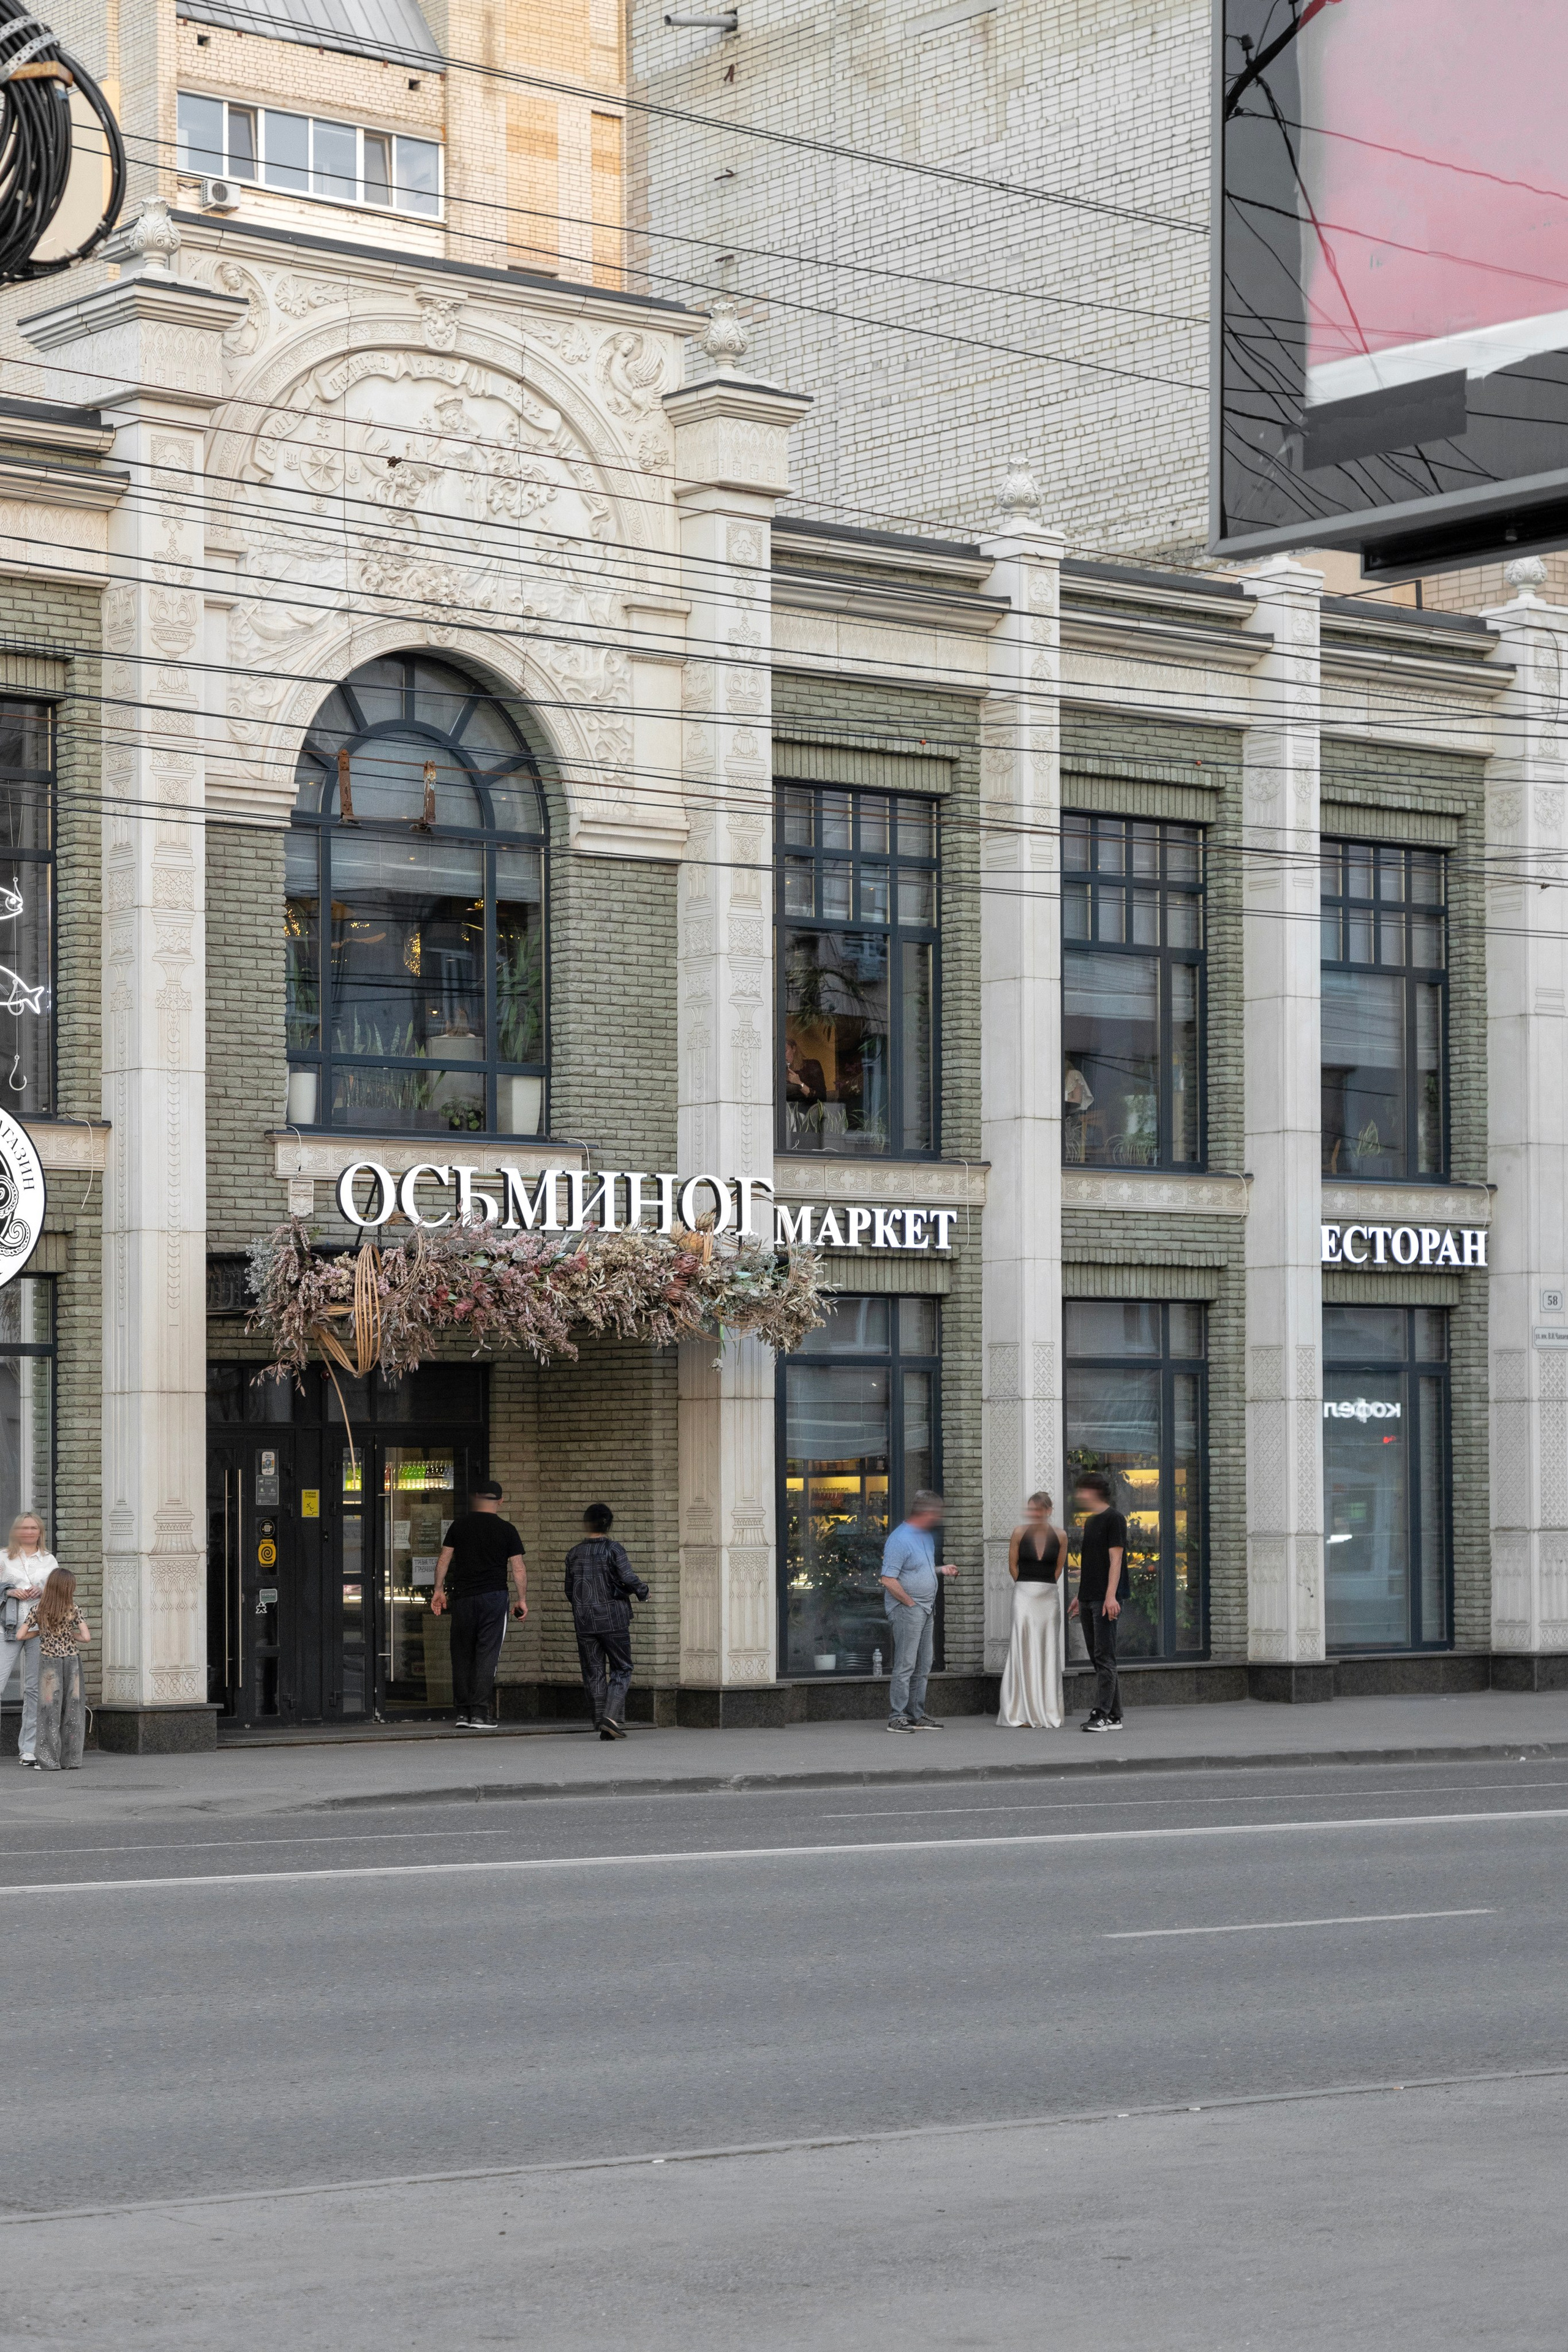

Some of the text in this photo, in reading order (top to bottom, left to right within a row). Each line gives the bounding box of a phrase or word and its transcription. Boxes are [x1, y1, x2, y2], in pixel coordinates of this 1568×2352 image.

[417, 360, 457, 379] 2020
[0, 1120, 35, 1191] ГАЗИН
[336, 1161, 775, 1235] ОСЬМИНОГ
[774, 1205, 957, 1250] МАРКЕТ
[1321, 1225, 1488, 1267] ЕСТОРАН
[1547, 1295, 1558, 1306] 58
